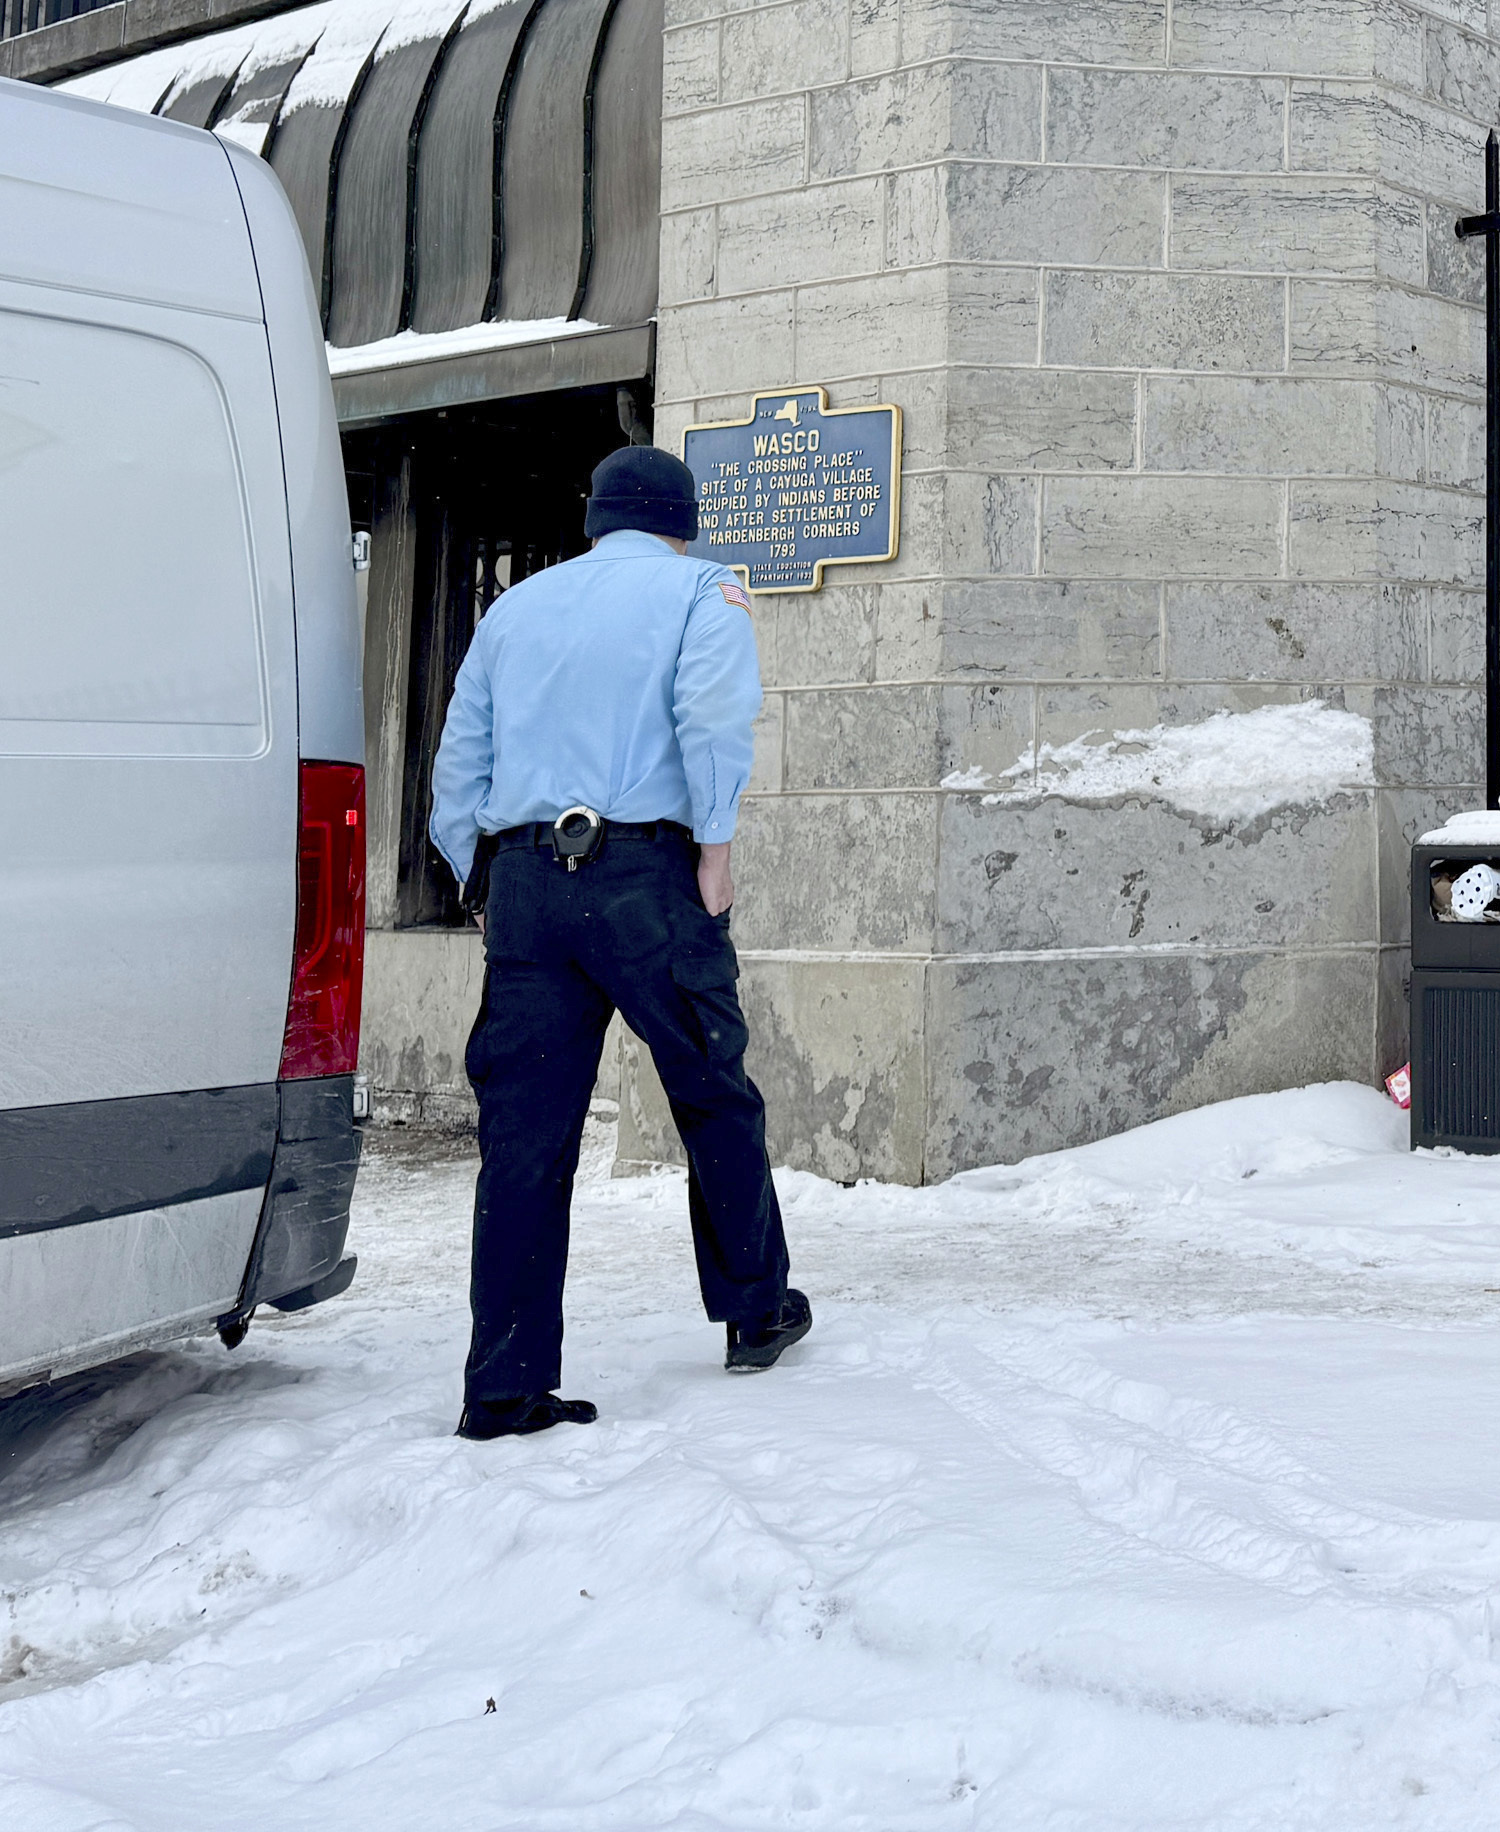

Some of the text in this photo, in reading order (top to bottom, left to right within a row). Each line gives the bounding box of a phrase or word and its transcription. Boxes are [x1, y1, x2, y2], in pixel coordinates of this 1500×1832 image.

[753, 429, 820, 457] WASCO
[711, 449, 864, 477] "THE CROSSING PLACE"
[701, 467, 873, 496] SITE OF A CAYUGA VILLAGE
[698, 484, 881, 512] CCUPIED BY INDIANS BEFORE
[726, 510, 764, 527] AFTER
[772, 503, 852, 523] SETTLEMENT
[860, 502, 876, 517] OF
[709, 521, 860, 545] HARDENBERGH CORNERS
[770, 543, 796, 558] 1793
